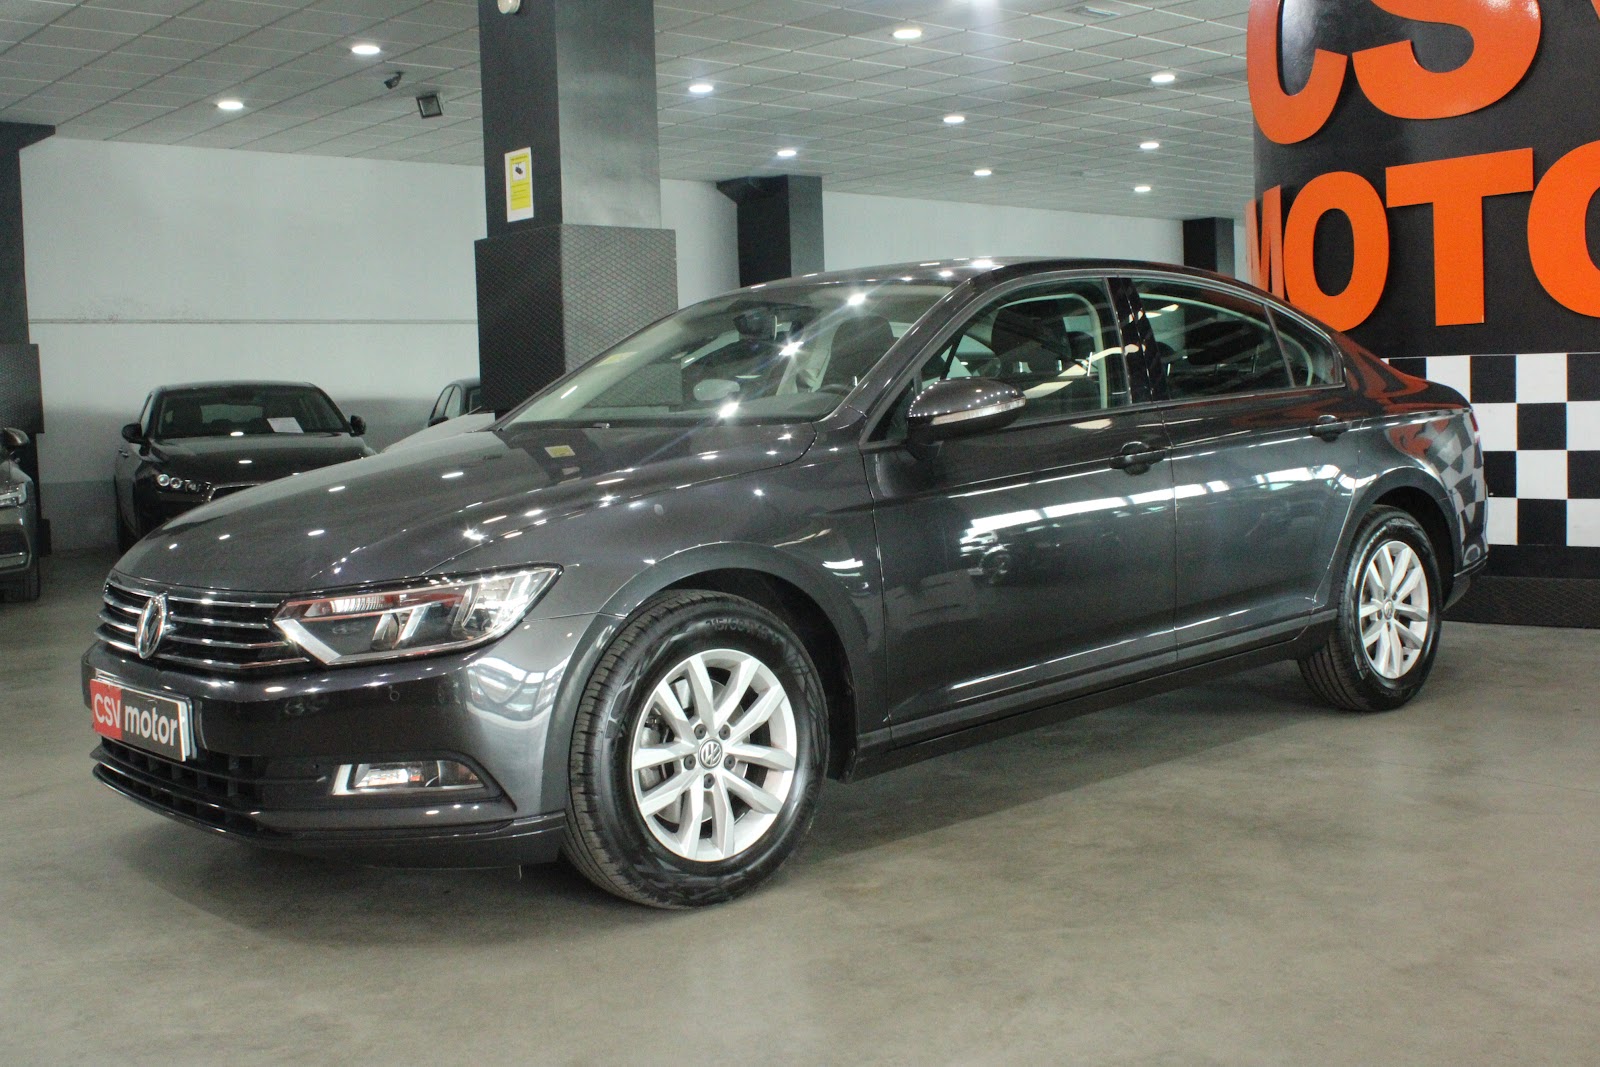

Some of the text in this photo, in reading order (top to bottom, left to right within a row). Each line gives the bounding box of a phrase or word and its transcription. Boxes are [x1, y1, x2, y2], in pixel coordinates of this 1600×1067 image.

[1246, 0, 1600, 144] CS
[94, 693, 178, 747] CSV motor
